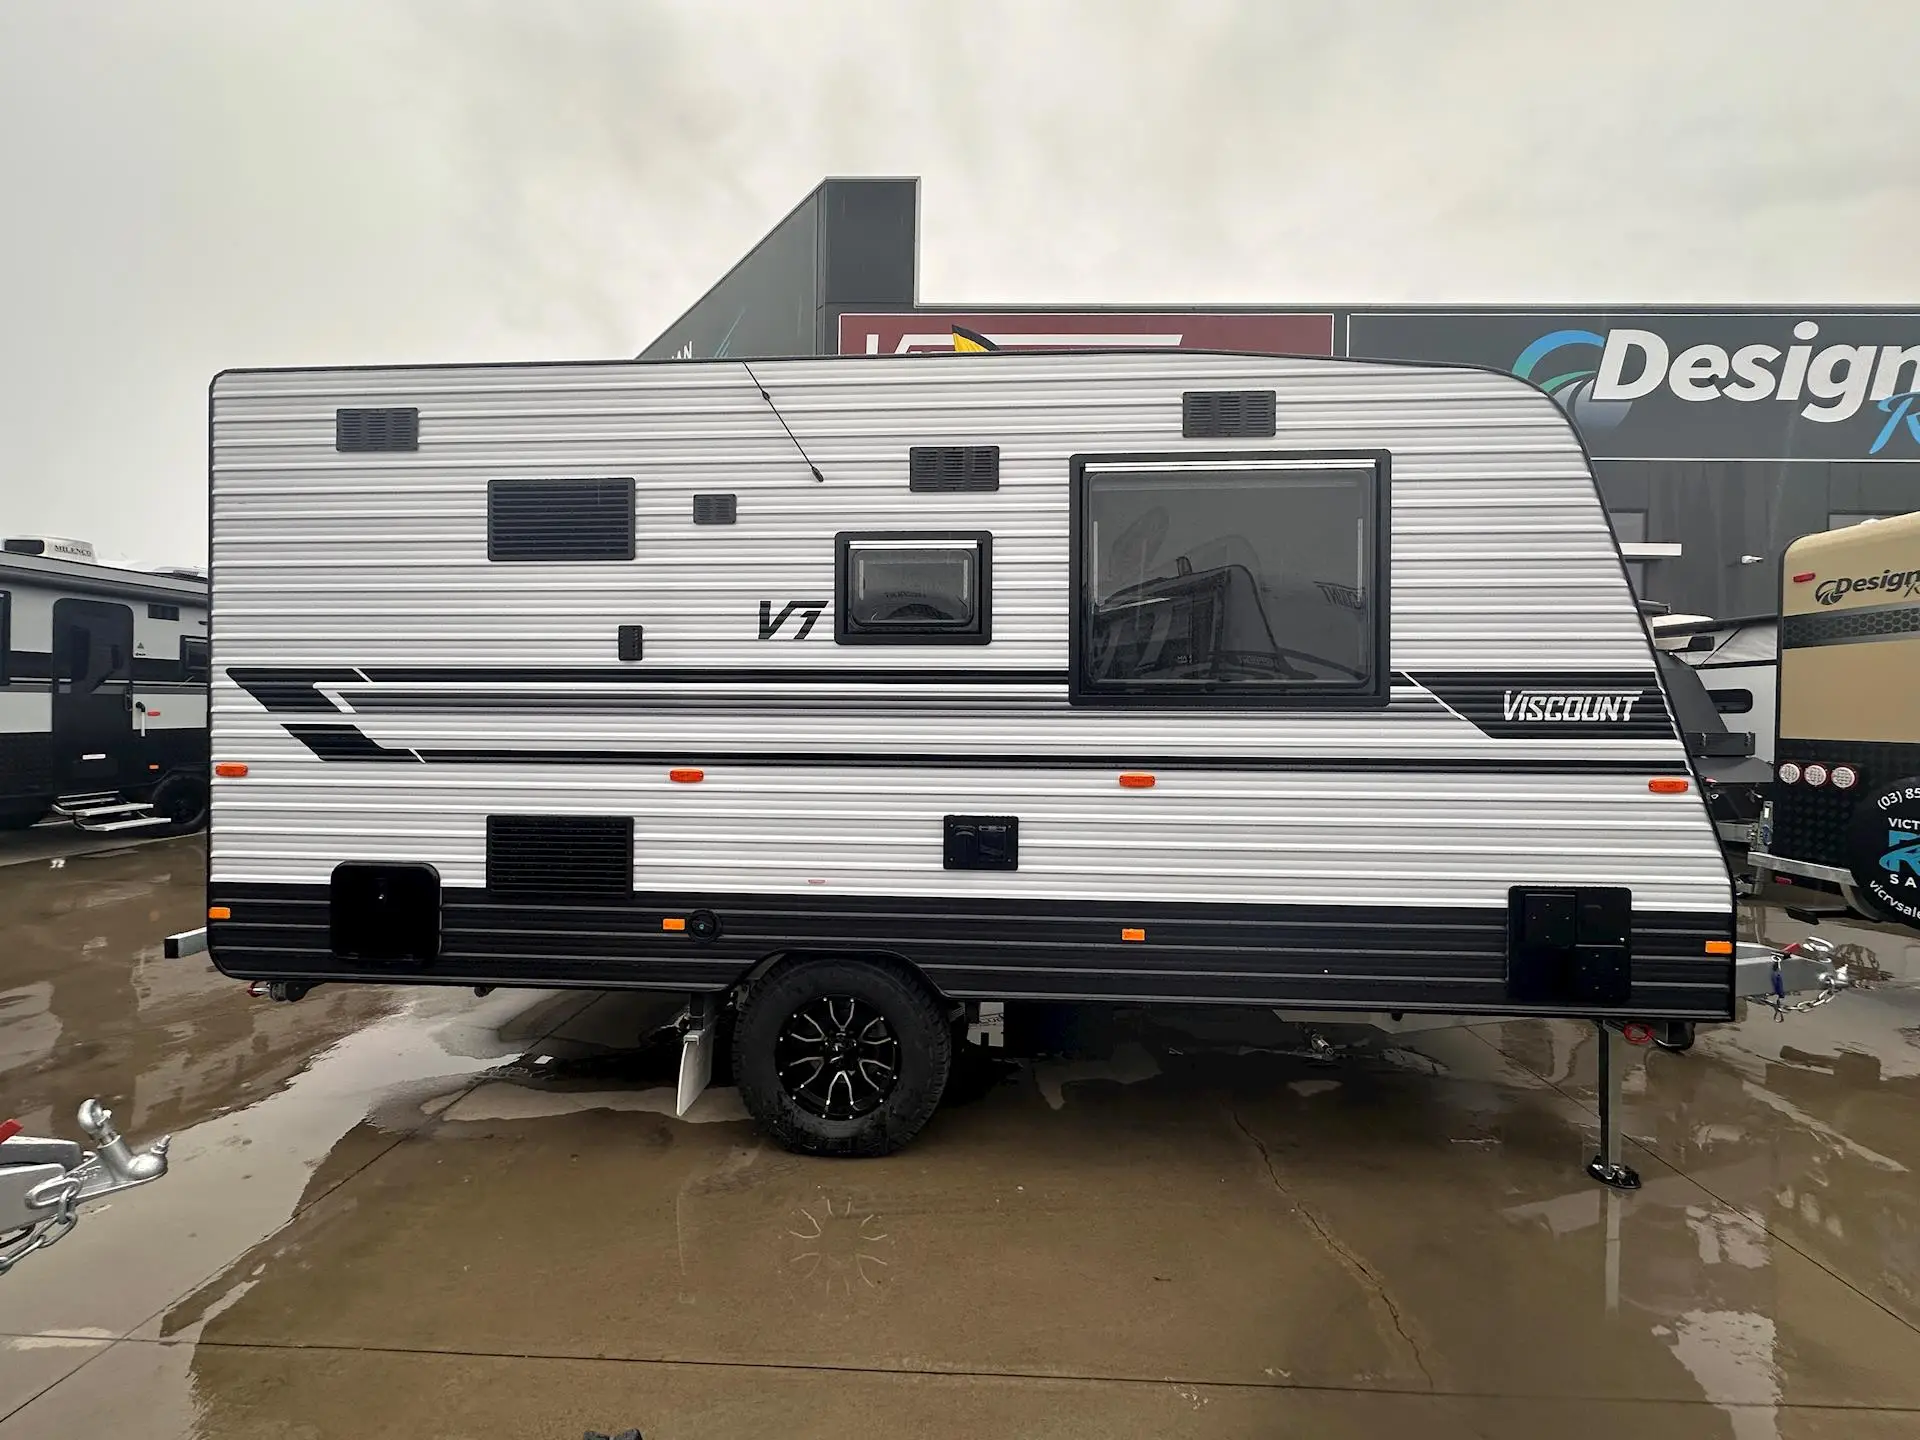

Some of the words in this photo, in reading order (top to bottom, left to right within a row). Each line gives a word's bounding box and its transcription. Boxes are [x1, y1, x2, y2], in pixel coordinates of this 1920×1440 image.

[1592, 321, 1920, 422] Design
[1503, 690, 1643, 721] VISCOUNT
[1877, 790, 1903, 810] (03)
[1888, 817, 1920, 830] VICT
